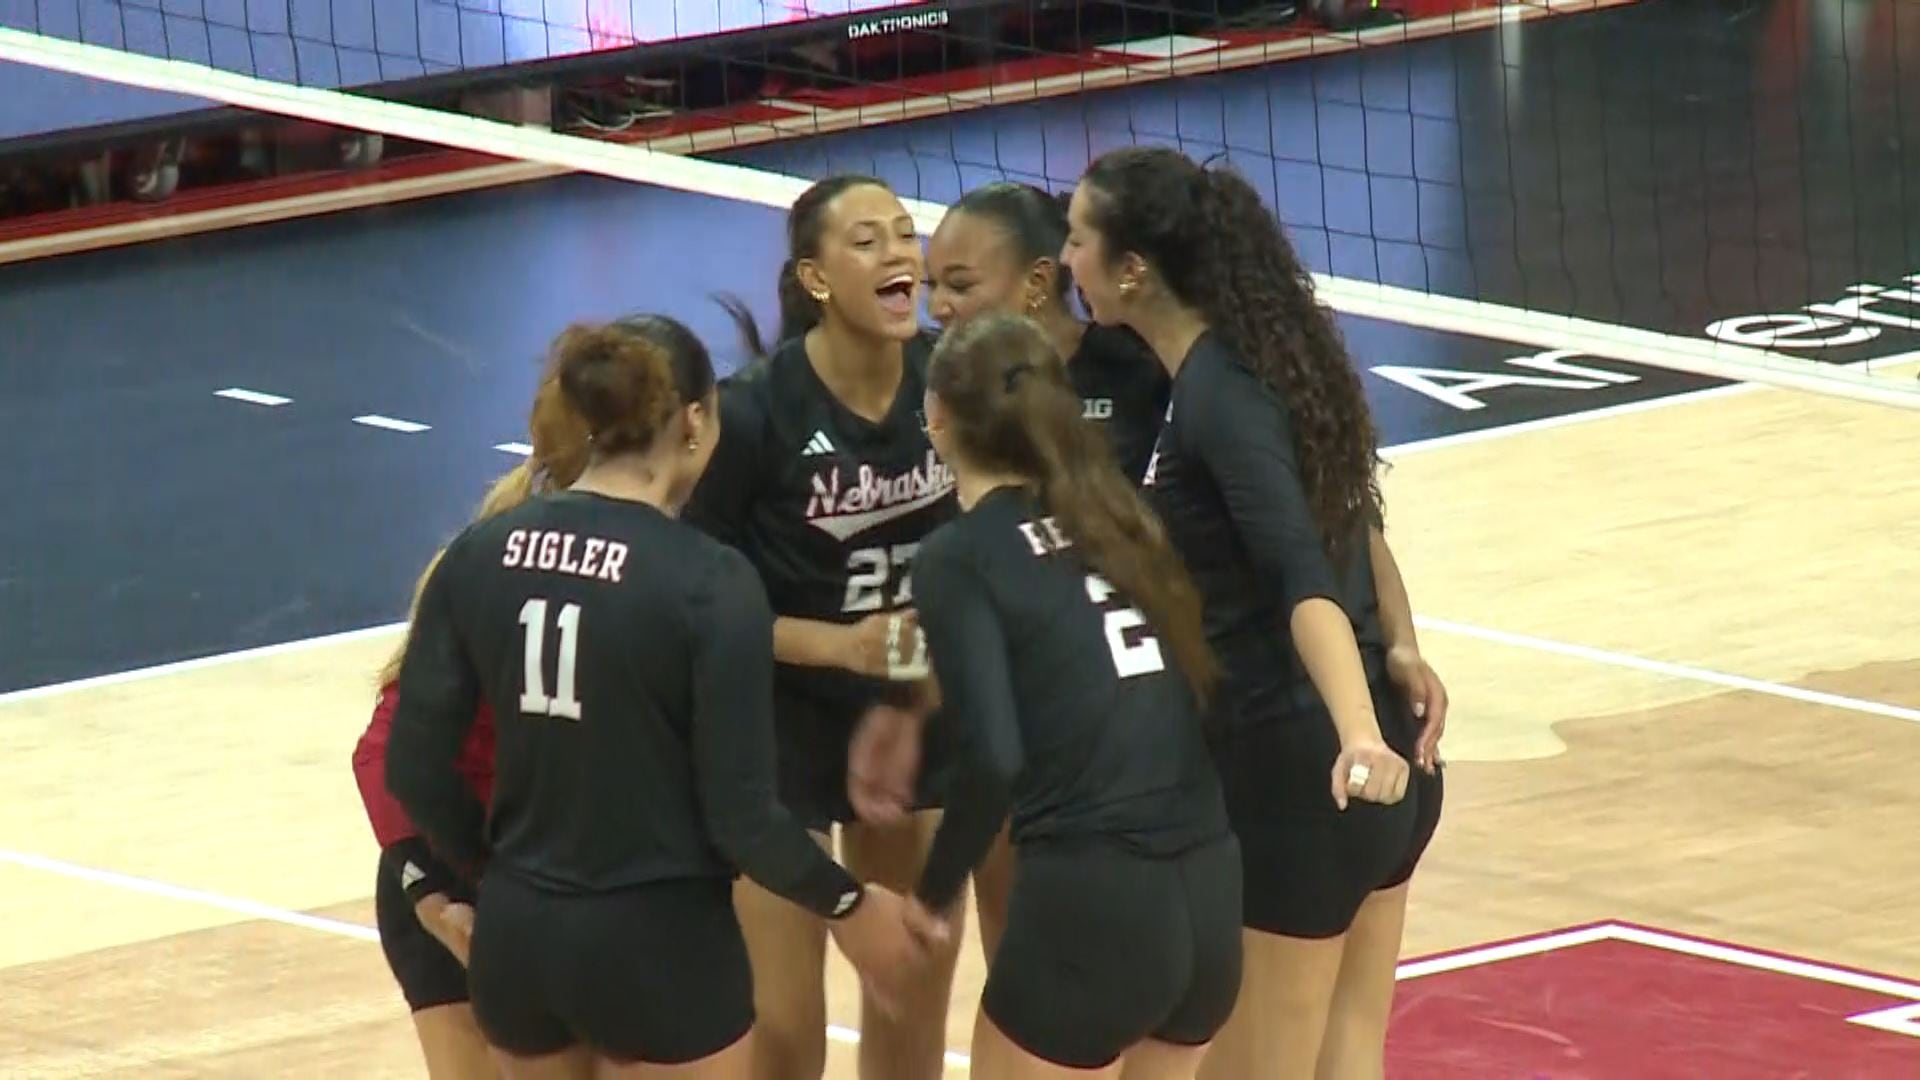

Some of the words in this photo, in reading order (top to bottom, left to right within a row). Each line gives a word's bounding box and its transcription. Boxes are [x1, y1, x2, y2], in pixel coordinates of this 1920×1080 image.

[502, 529, 629, 583] SIGLER
[840, 543, 921, 613] 27
[518, 597, 582, 721] 11
